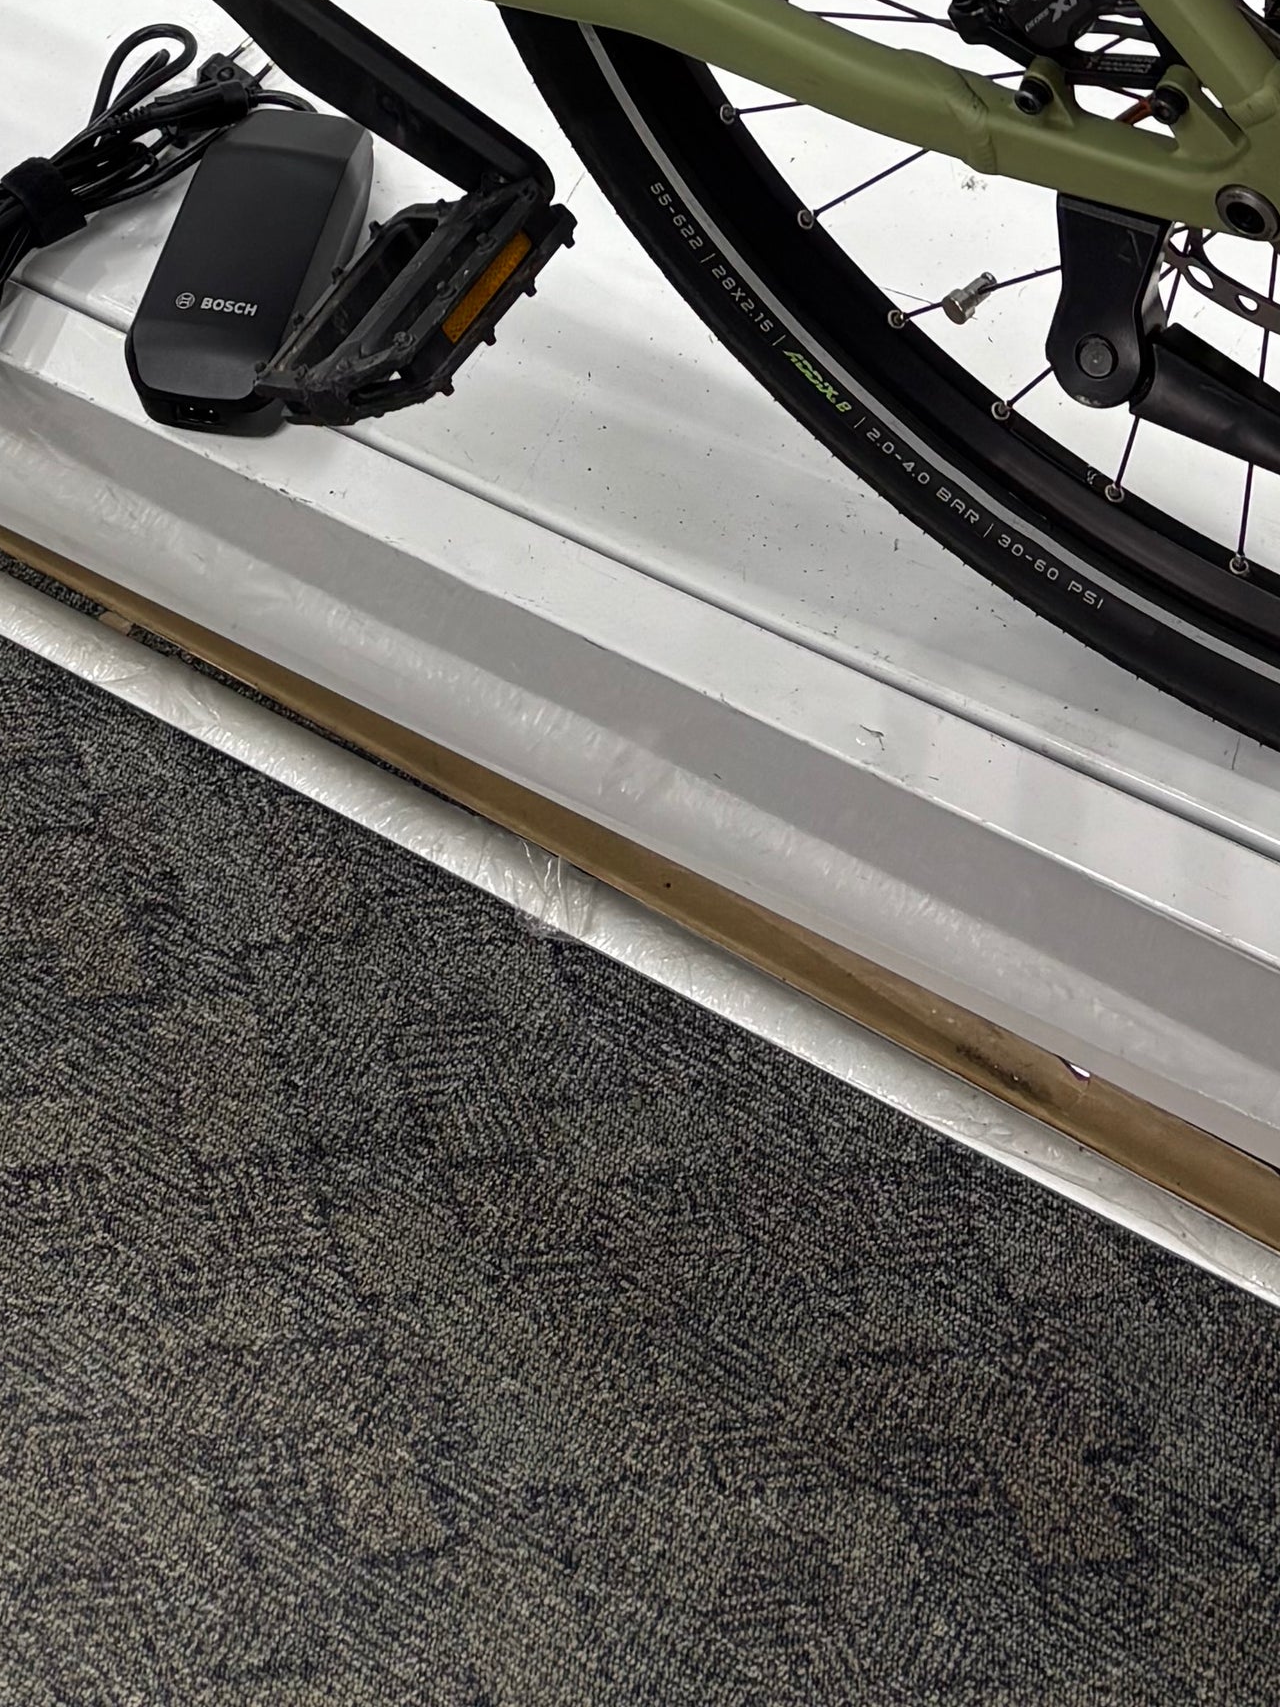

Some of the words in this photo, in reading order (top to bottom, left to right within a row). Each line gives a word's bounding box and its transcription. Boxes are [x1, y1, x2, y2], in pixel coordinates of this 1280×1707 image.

[200, 297, 258, 317] BOSCH
[650, 181, 704, 250] 55-622
[866, 427, 931, 485] 2.0-4.0
[935, 487, 980, 525] BAR
[997, 533, 1060, 582] 30-60
[1067, 581, 1105, 610] PSI
